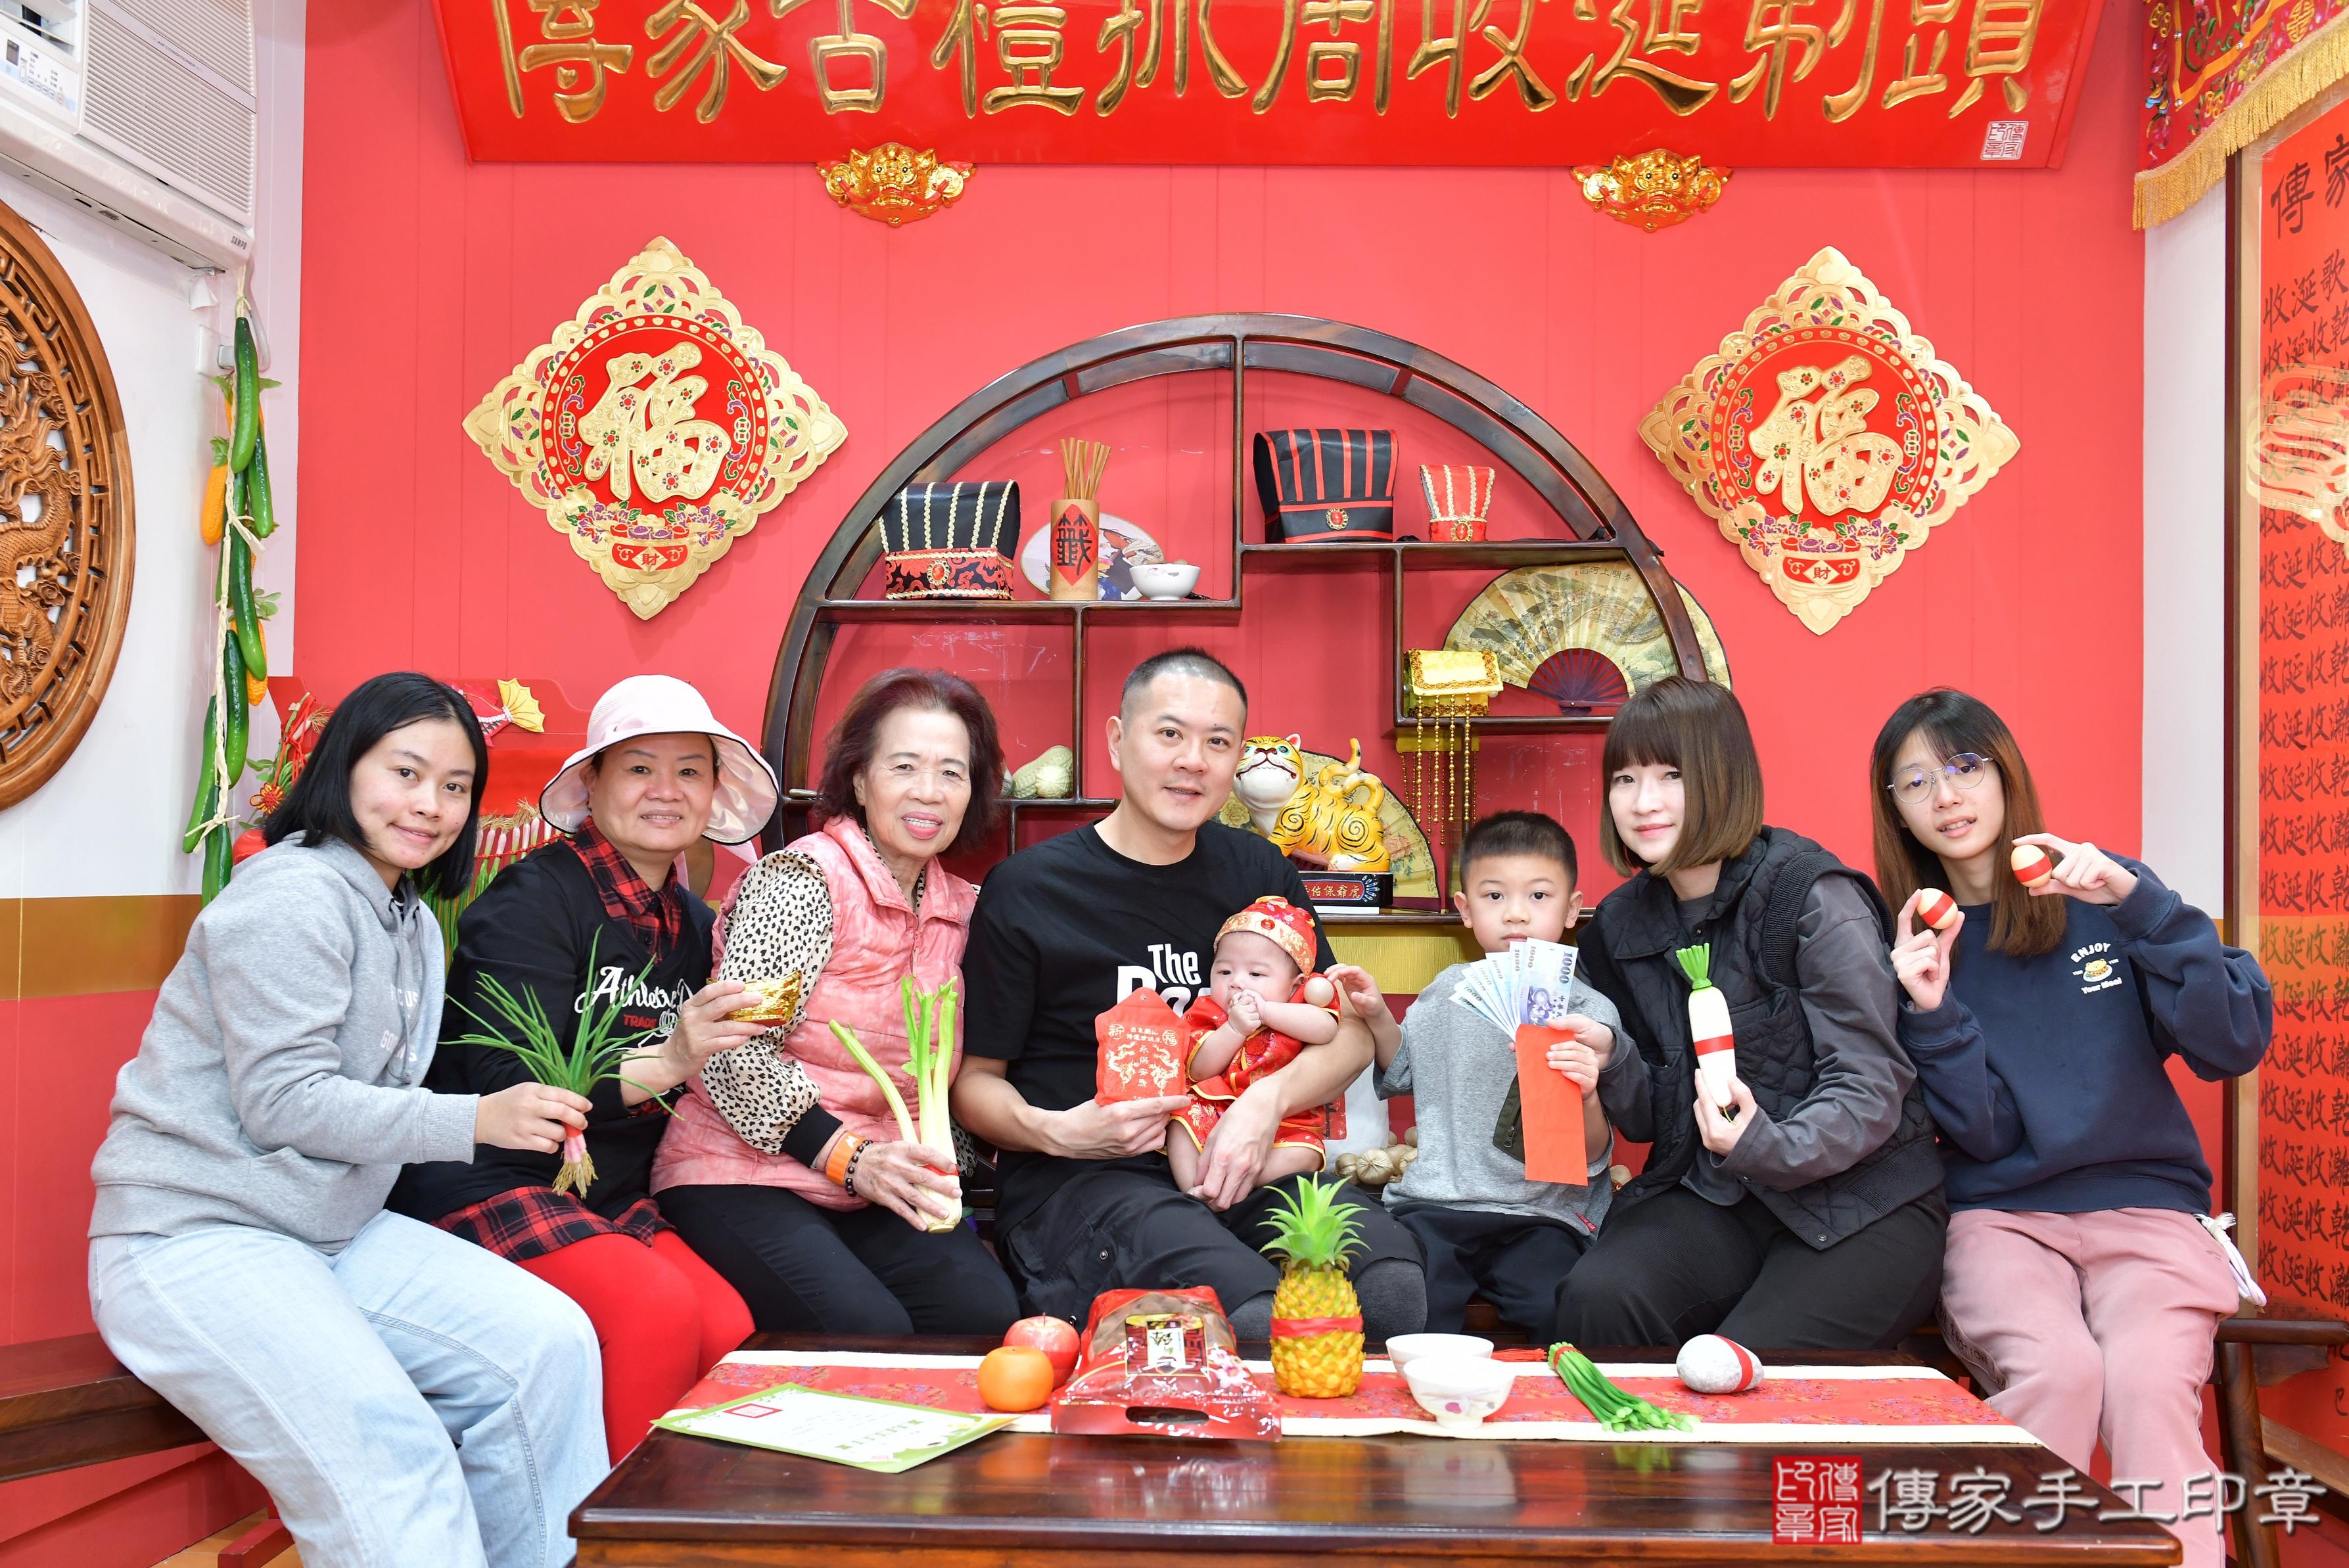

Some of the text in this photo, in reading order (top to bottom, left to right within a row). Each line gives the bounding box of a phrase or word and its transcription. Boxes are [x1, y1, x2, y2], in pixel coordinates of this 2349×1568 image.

[231, 236, 247, 250] SAMPO
[578, 341, 731, 503] 福
[1749, 354, 1903, 515] 福
[1056, 513, 1092, 576] 籤
[641, 553, 659, 566] 財
[1813, 566, 1830, 580] 財
[1527, 946, 1537, 968] 1000
[2070, 942, 2111, 963] ENJOY
[1147, 943, 1202, 985] The
[1492, 959, 1503, 980] 1000
[1559, 951, 1573, 984] 1000
[1464, 986, 1482, 1002] 1000
